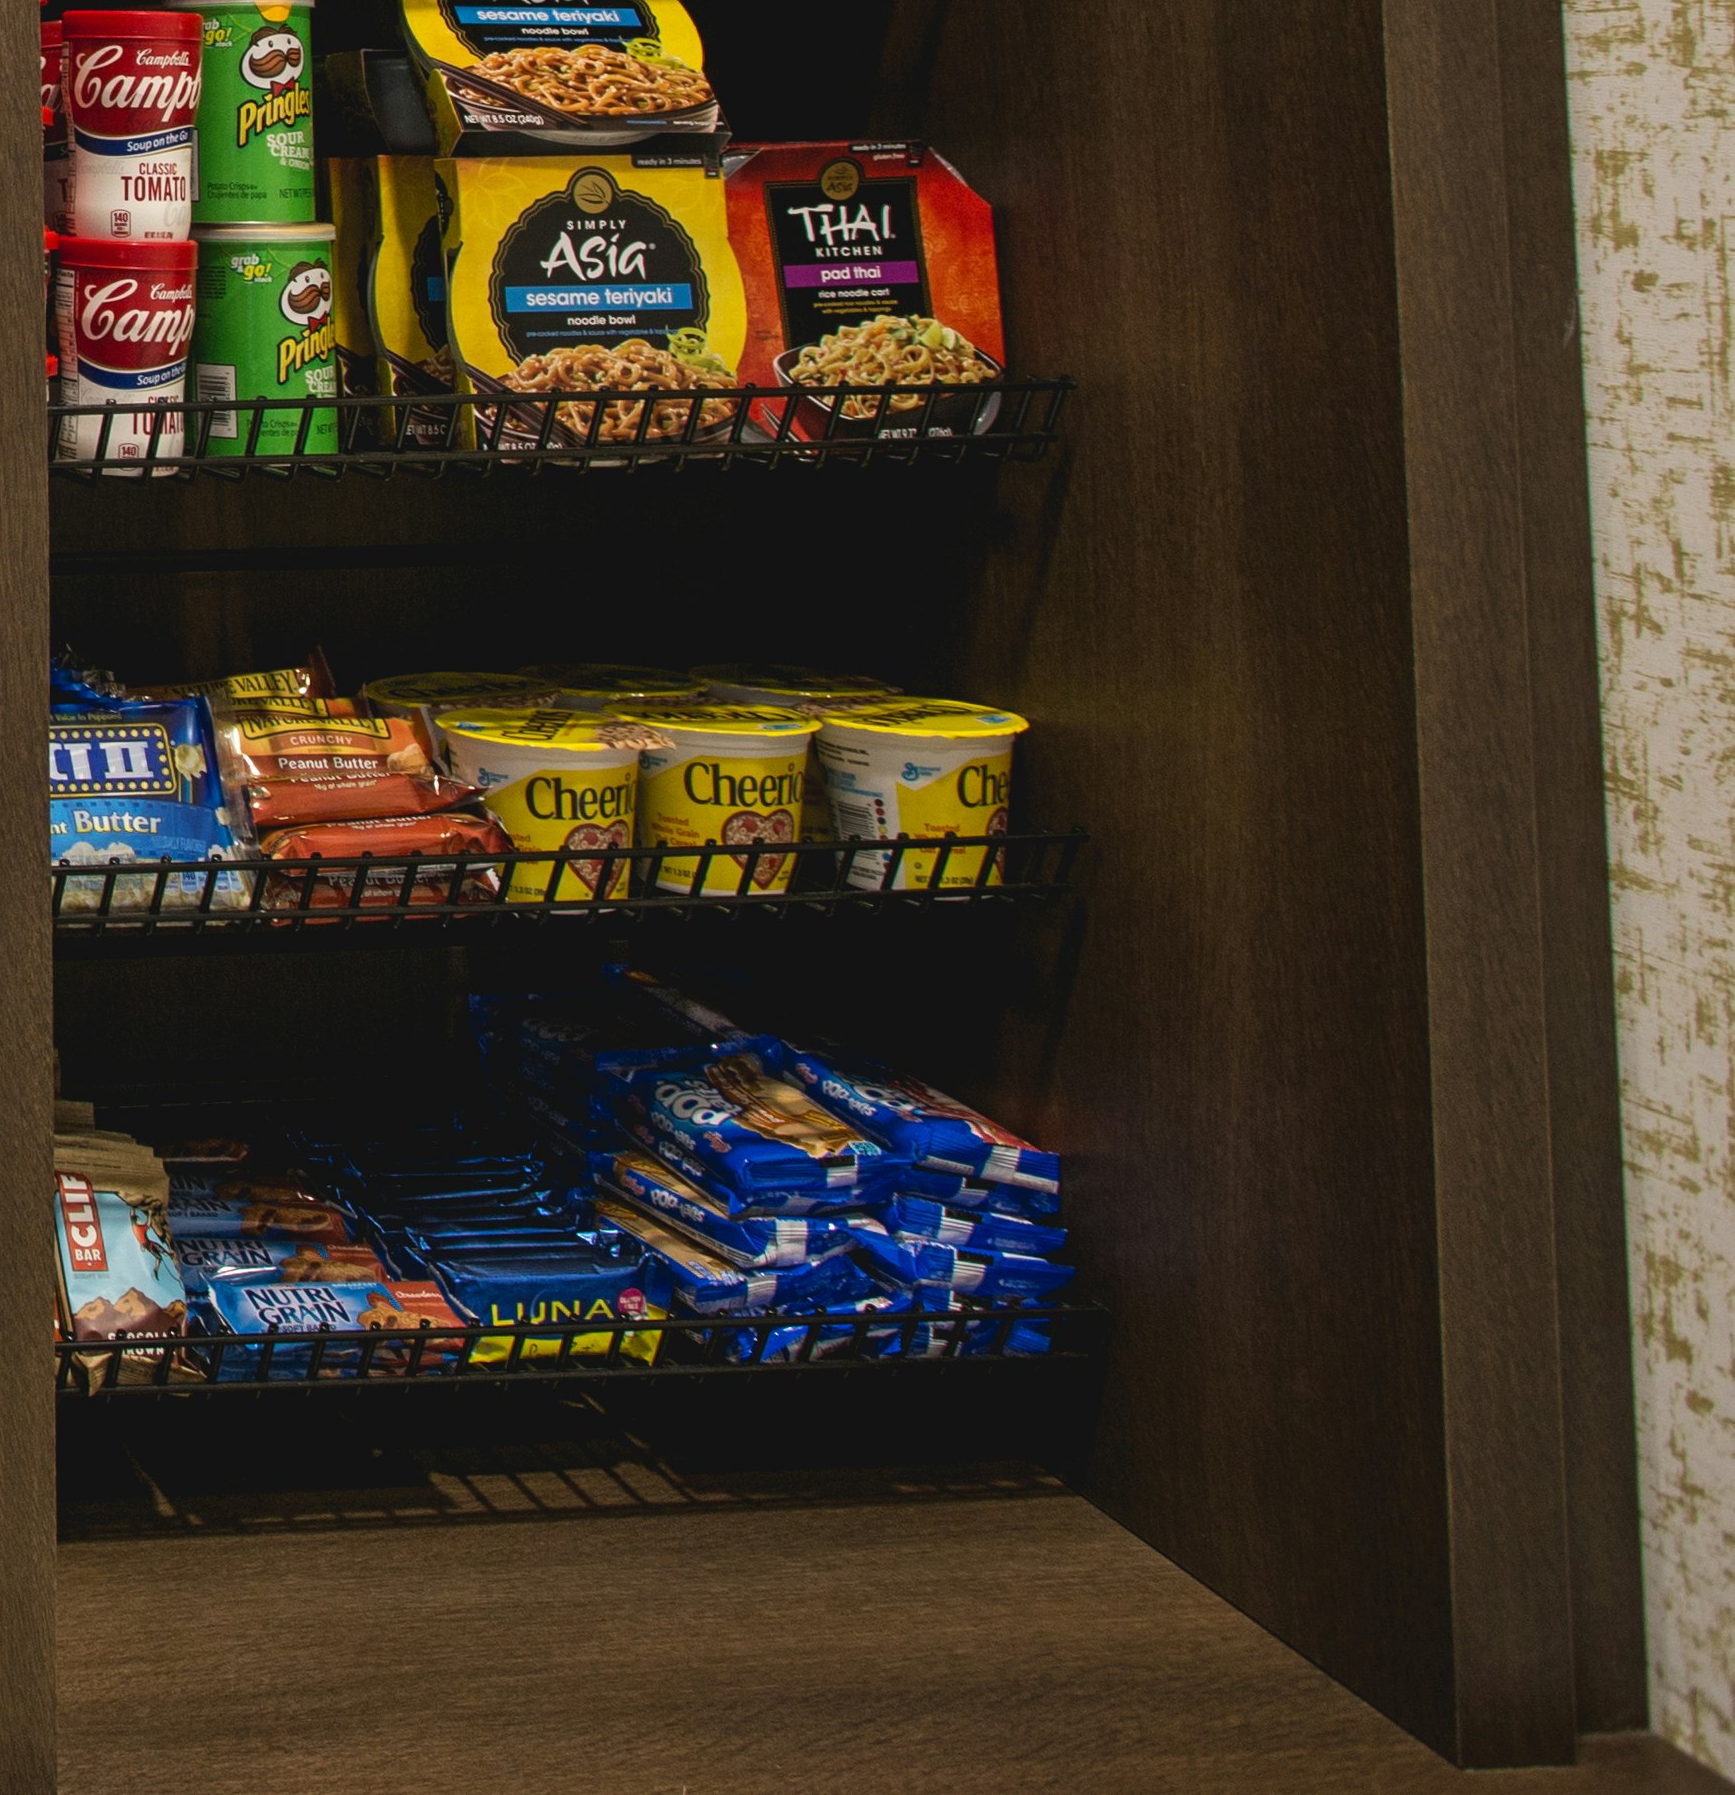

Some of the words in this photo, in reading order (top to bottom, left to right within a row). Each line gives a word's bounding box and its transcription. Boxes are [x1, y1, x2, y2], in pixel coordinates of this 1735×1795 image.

[476, 8, 550, 23] sesame
[551, 7, 621, 26] teriyaki
[520, 26, 559, 36] noodle
[561, 25, 589, 36] bowl
[237, 87, 311, 148] Pringles
[126, 138, 147, 152] Soup
[267, 131, 305, 147] SOUR
[139, 162, 177, 176] CLASSIC
[121, 176, 186, 202] TOMATO
[567, 220, 627, 230] SIMPLY
[787, 204, 892, 246] THAI
[540, 231, 647, 281] Asia
[815, 246, 883, 258] KITCHEN
[821, 266, 851, 282] pad
[853, 265, 881, 279] thai
[526, 290, 601, 306] sesame
[605, 287, 672, 308] teriyaki
[838, 289, 870, 298] noodle
[567, 315, 606, 325] noodle
[609, 314, 636, 325] bowl
[237, 673, 294, 695] VALLEY
[290, 735, 353, 746] CRUNCHY
[278, 757, 329, 770] Peanut
[333, 757, 379, 771] Butter
[683, 761, 805, 810] Cheerio
[73, 809, 162, 836] Butter
[61, 1174, 98, 1249] CLIF
[75, 1249, 102, 1263] BAR
[244, 1288, 336, 1307] NUTRI
[258, 1303, 352, 1326] GRAIN
[491, 1298, 613, 1327] LUNA
